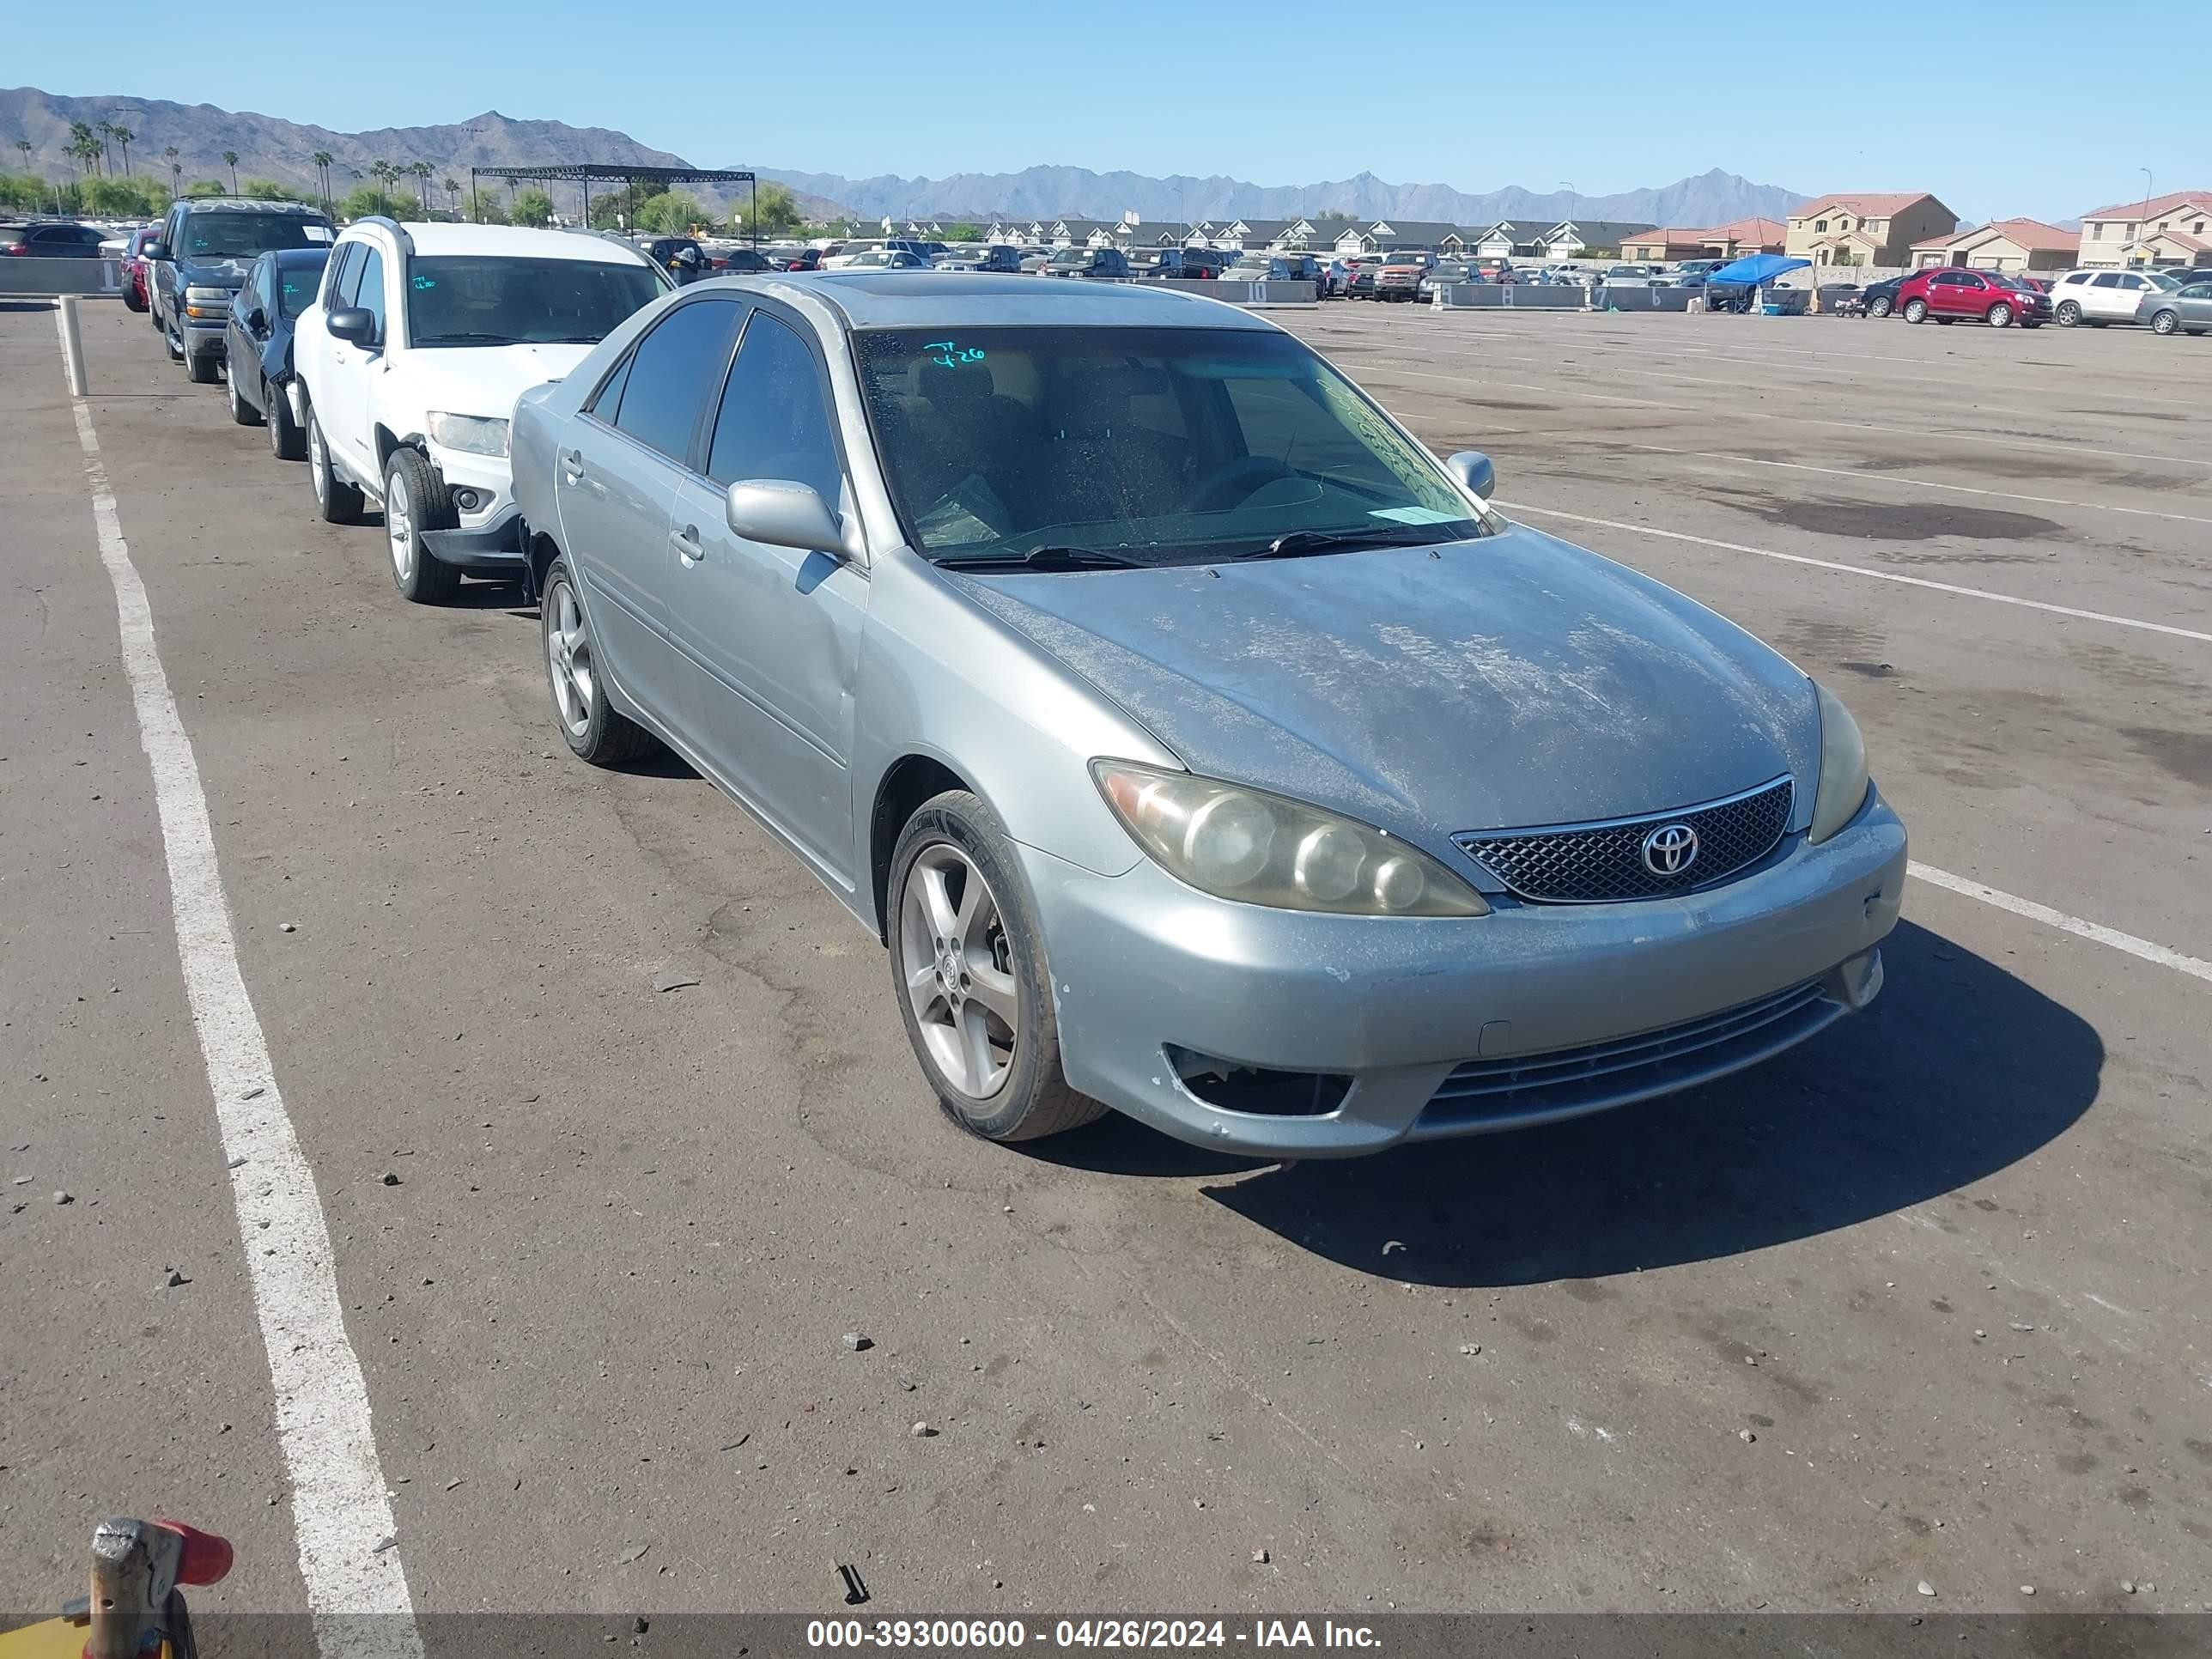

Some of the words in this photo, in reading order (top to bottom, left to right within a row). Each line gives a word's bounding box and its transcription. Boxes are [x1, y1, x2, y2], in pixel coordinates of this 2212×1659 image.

[1247, 282, 1267, 304] 10
[1502, 285, 1514, 307] 8
[1595, 287, 1607, 307] 7
